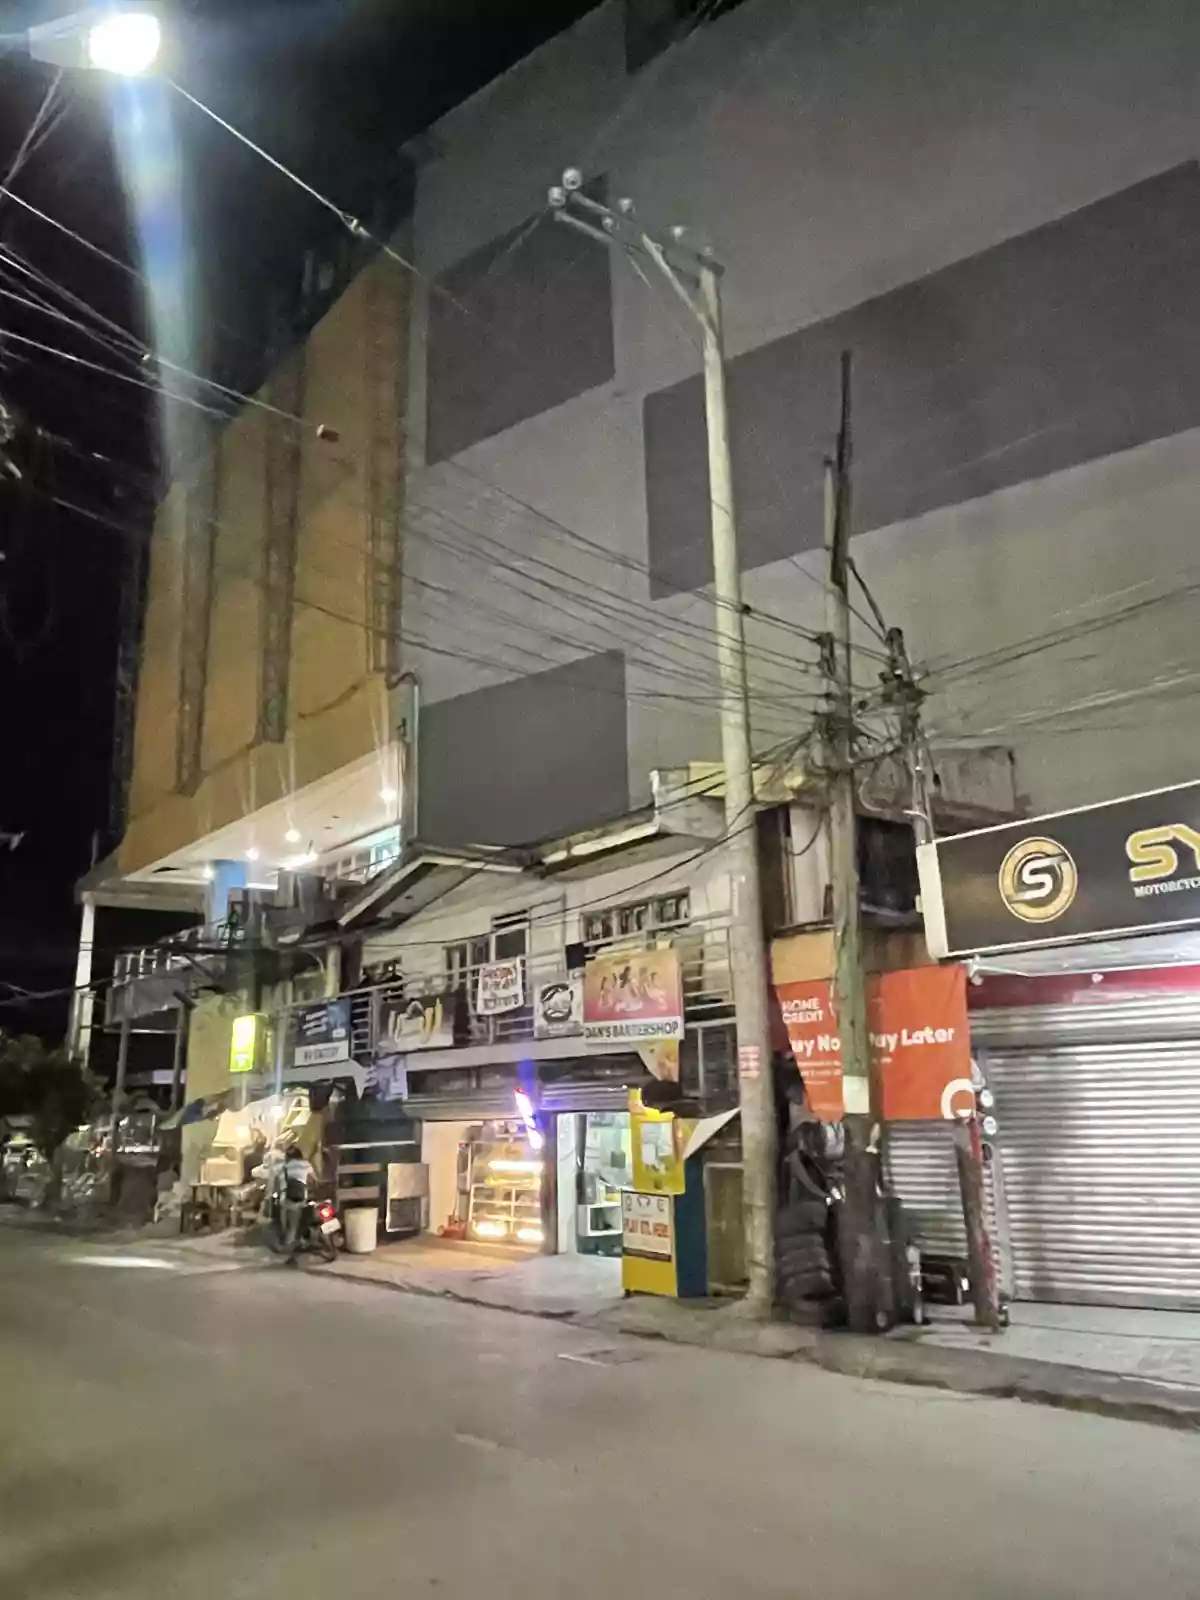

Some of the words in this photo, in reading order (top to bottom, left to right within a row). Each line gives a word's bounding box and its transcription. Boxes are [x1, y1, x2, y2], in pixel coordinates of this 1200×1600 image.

[789, 1038, 815, 1058] uy
[817, 1034, 841, 1052] No
[901, 1026, 955, 1046] Later
